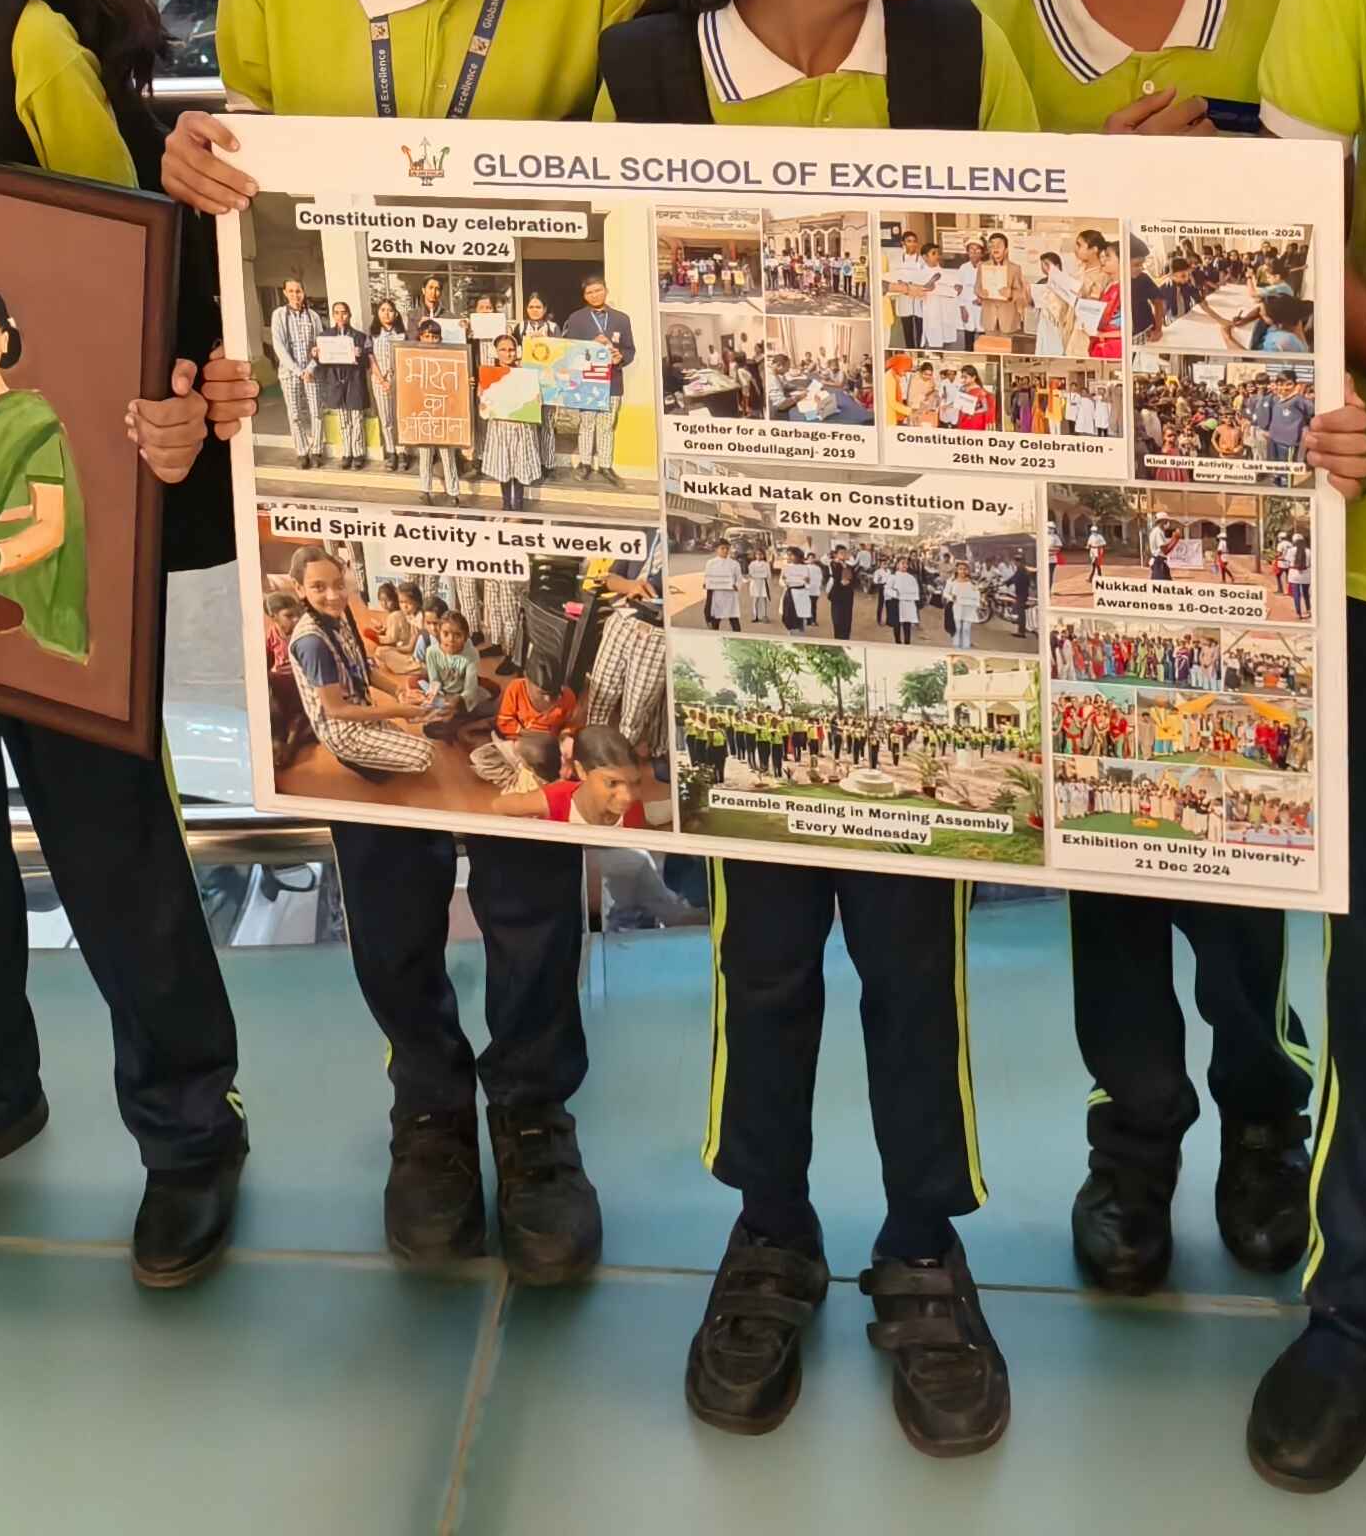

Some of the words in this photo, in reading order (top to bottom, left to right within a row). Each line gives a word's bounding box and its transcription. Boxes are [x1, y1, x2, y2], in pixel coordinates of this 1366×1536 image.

[473, 153, 610, 180] GLOBAL
[620, 156, 762, 184] SCHOOL
[772, 161, 817, 186] OF
[830, 162, 1065, 193] EXCELLENCE
[298, 210, 415, 227] Constitution
[421, 213, 458, 233] Day
[464, 215, 582, 233] celebration-
[370, 237, 413, 253] 26th
[419, 239, 456, 255] Nov
[462, 241, 510, 256] 2024
[683, 480, 752, 497] Nukkad
[758, 485, 813, 501] Natak
[819, 491, 842, 503] on
[848, 490, 964, 510] Constitution
[971, 498, 1013, 515] Day-
[779, 509, 820, 525] 26th
[827, 512, 862, 527] Nov
[867, 515, 914, 531] 2019
[274, 515, 322, 533] Kind
[328, 519, 386, 539] Spirit
[393, 523, 477, 547] Activity
[497, 529, 545, 548] Last
[551, 535, 612, 552] week
[619, 538, 641, 554] of
[389, 554, 448, 573] every
[455, 558, 524, 575] month
[711, 793, 780, 809] Preamble
[785, 799, 845, 818] Reading
[849, 805, 863, 817] in
[868, 807, 930, 825] Morning
[934, 813, 1009, 832] Assembly
[788, 819, 837, 836] -Every
[841, 823, 927, 843] Wednesday
[1061, 833, 1138, 849] Exhibition
[1142, 842, 1162, 851] on
[1166, 842, 1207, 858] Unity
[1212, 846, 1226, 857] in
[1231, 848, 1305, 866] Diversity-
[1135, 858, 1153, 869] 21
[1158, 859, 1187, 872] Dec
[1192, 862, 1230, 876] 2024
